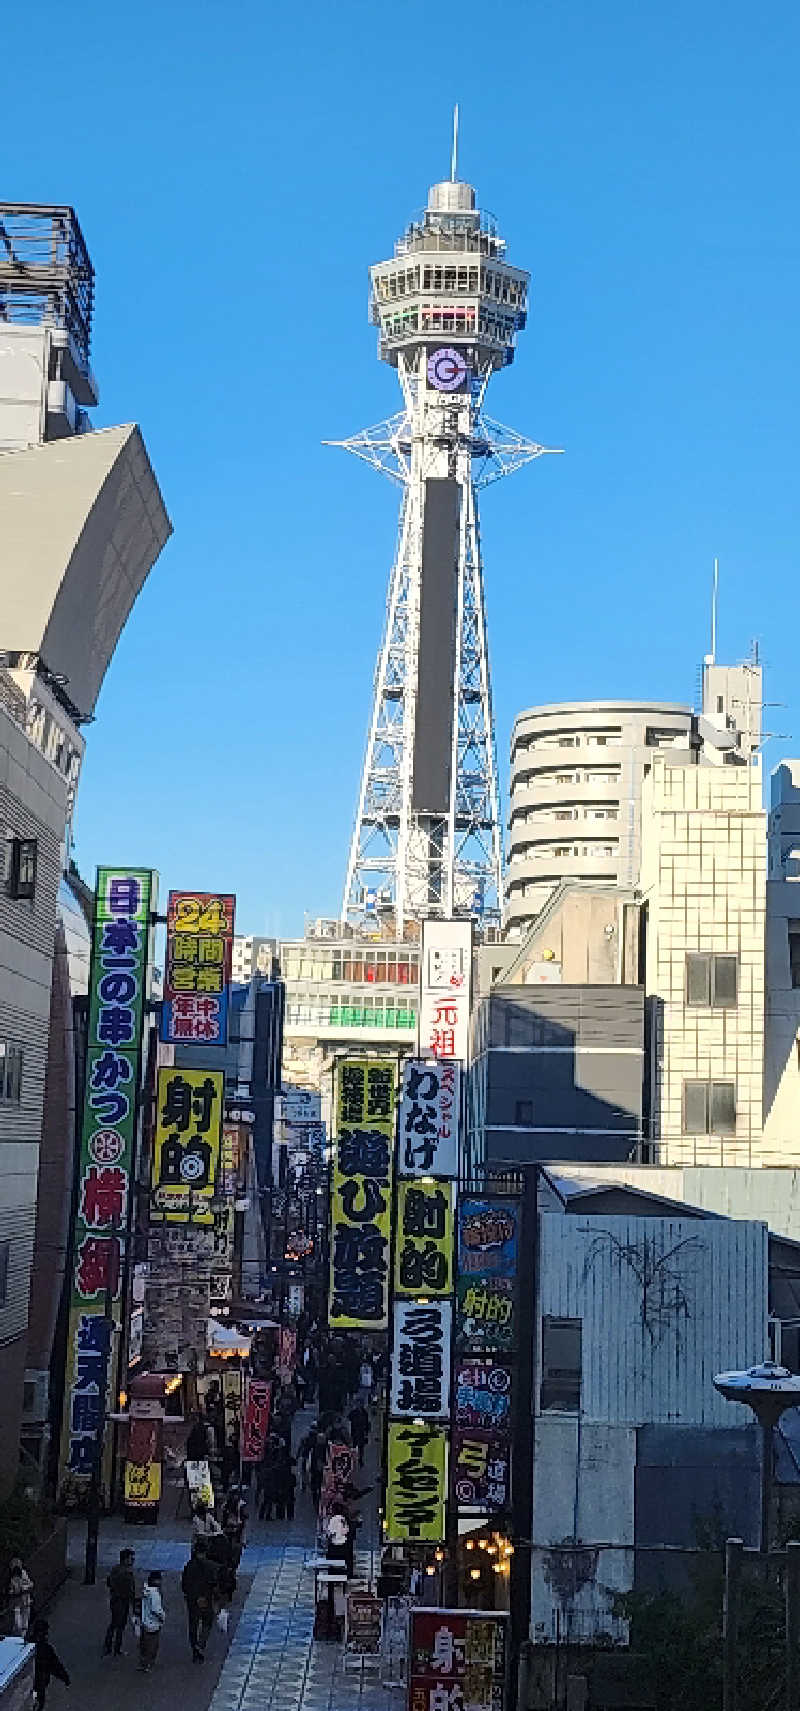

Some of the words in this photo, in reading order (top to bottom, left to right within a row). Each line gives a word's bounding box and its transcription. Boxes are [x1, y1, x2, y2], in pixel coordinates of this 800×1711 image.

[172, 936, 224, 966] 時間
[175, 899, 227, 935] 24
[89, 876, 142, 1126] 日本一の串かつ
[430, 998, 458, 1058] 元祖
[162, 1075, 218, 1189] 射的
[404, 1066, 440, 1170] わなげ
[77, 1165, 129, 1299] 横綱
[332, 1129, 392, 1320] 遊び放題
[402, 1187, 448, 1290] 射的
[397, 1308, 444, 1413] 弓道場
[392, 1427, 441, 1537] ゲームセンター
